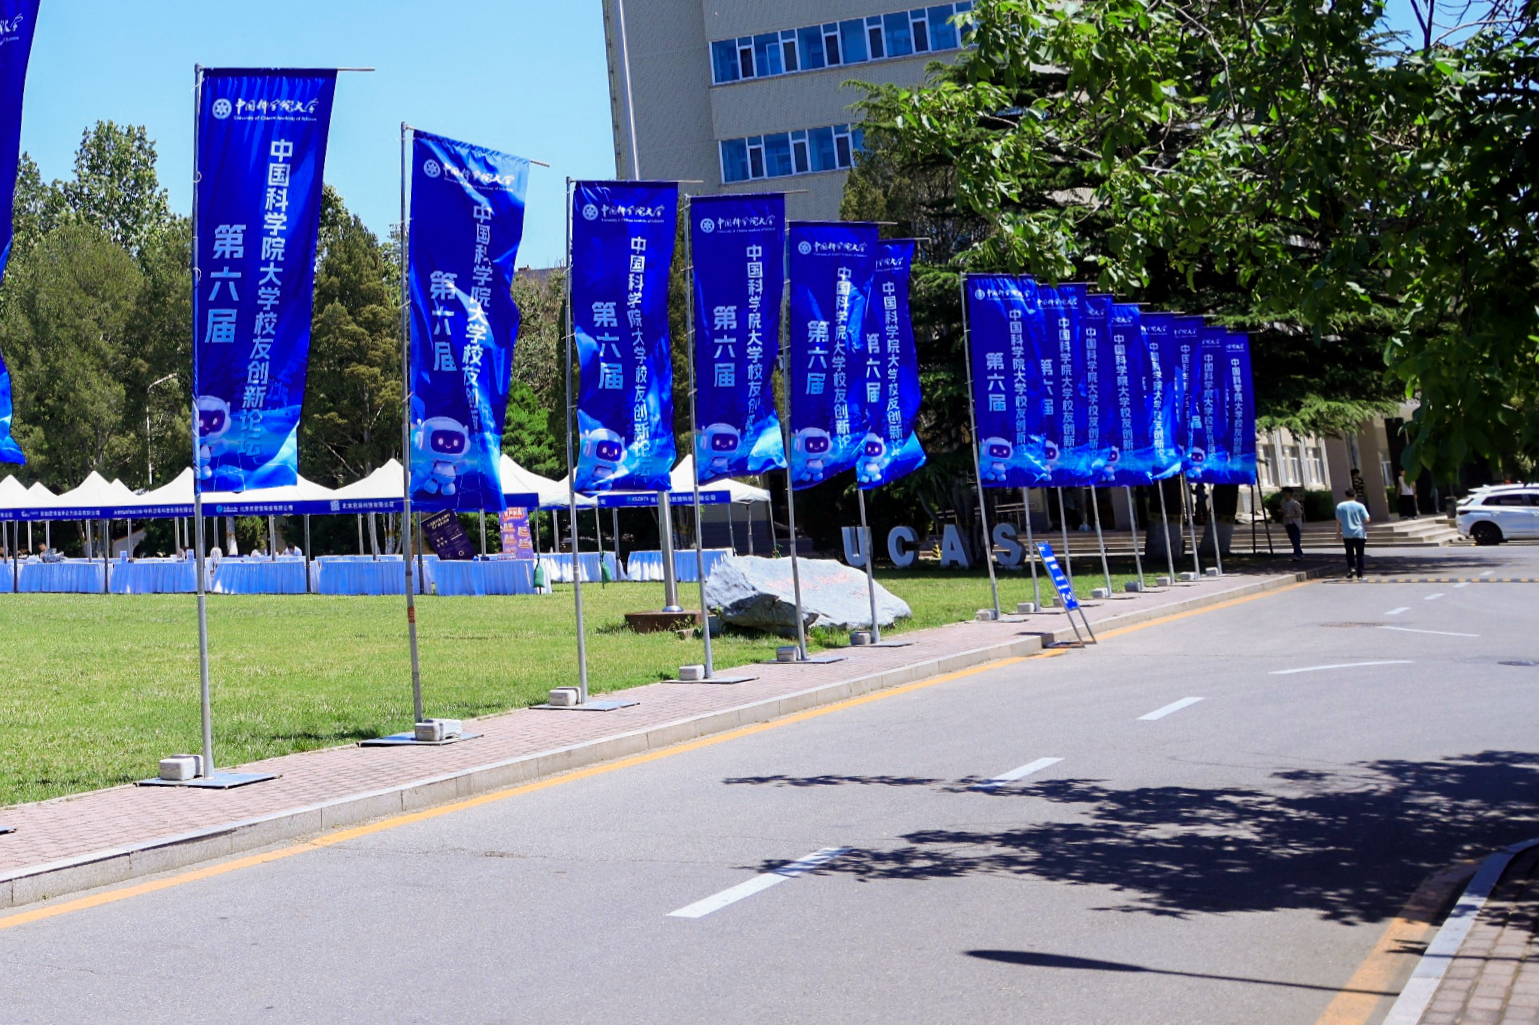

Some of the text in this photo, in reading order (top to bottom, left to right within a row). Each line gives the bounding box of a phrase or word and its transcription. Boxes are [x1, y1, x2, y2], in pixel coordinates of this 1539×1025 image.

[205, 224, 246, 343] 第六届
[237, 138, 293, 457] 中国科学院大学校友创新论坛
[430, 270, 458, 372] 第六届
[592, 302, 624, 390] 第六届
[713, 305, 737, 387] 第六届
[806, 320, 830, 395] 第六届
[985, 352, 1007, 412] 第六届
[841, 522, 1025, 568] UCAS
